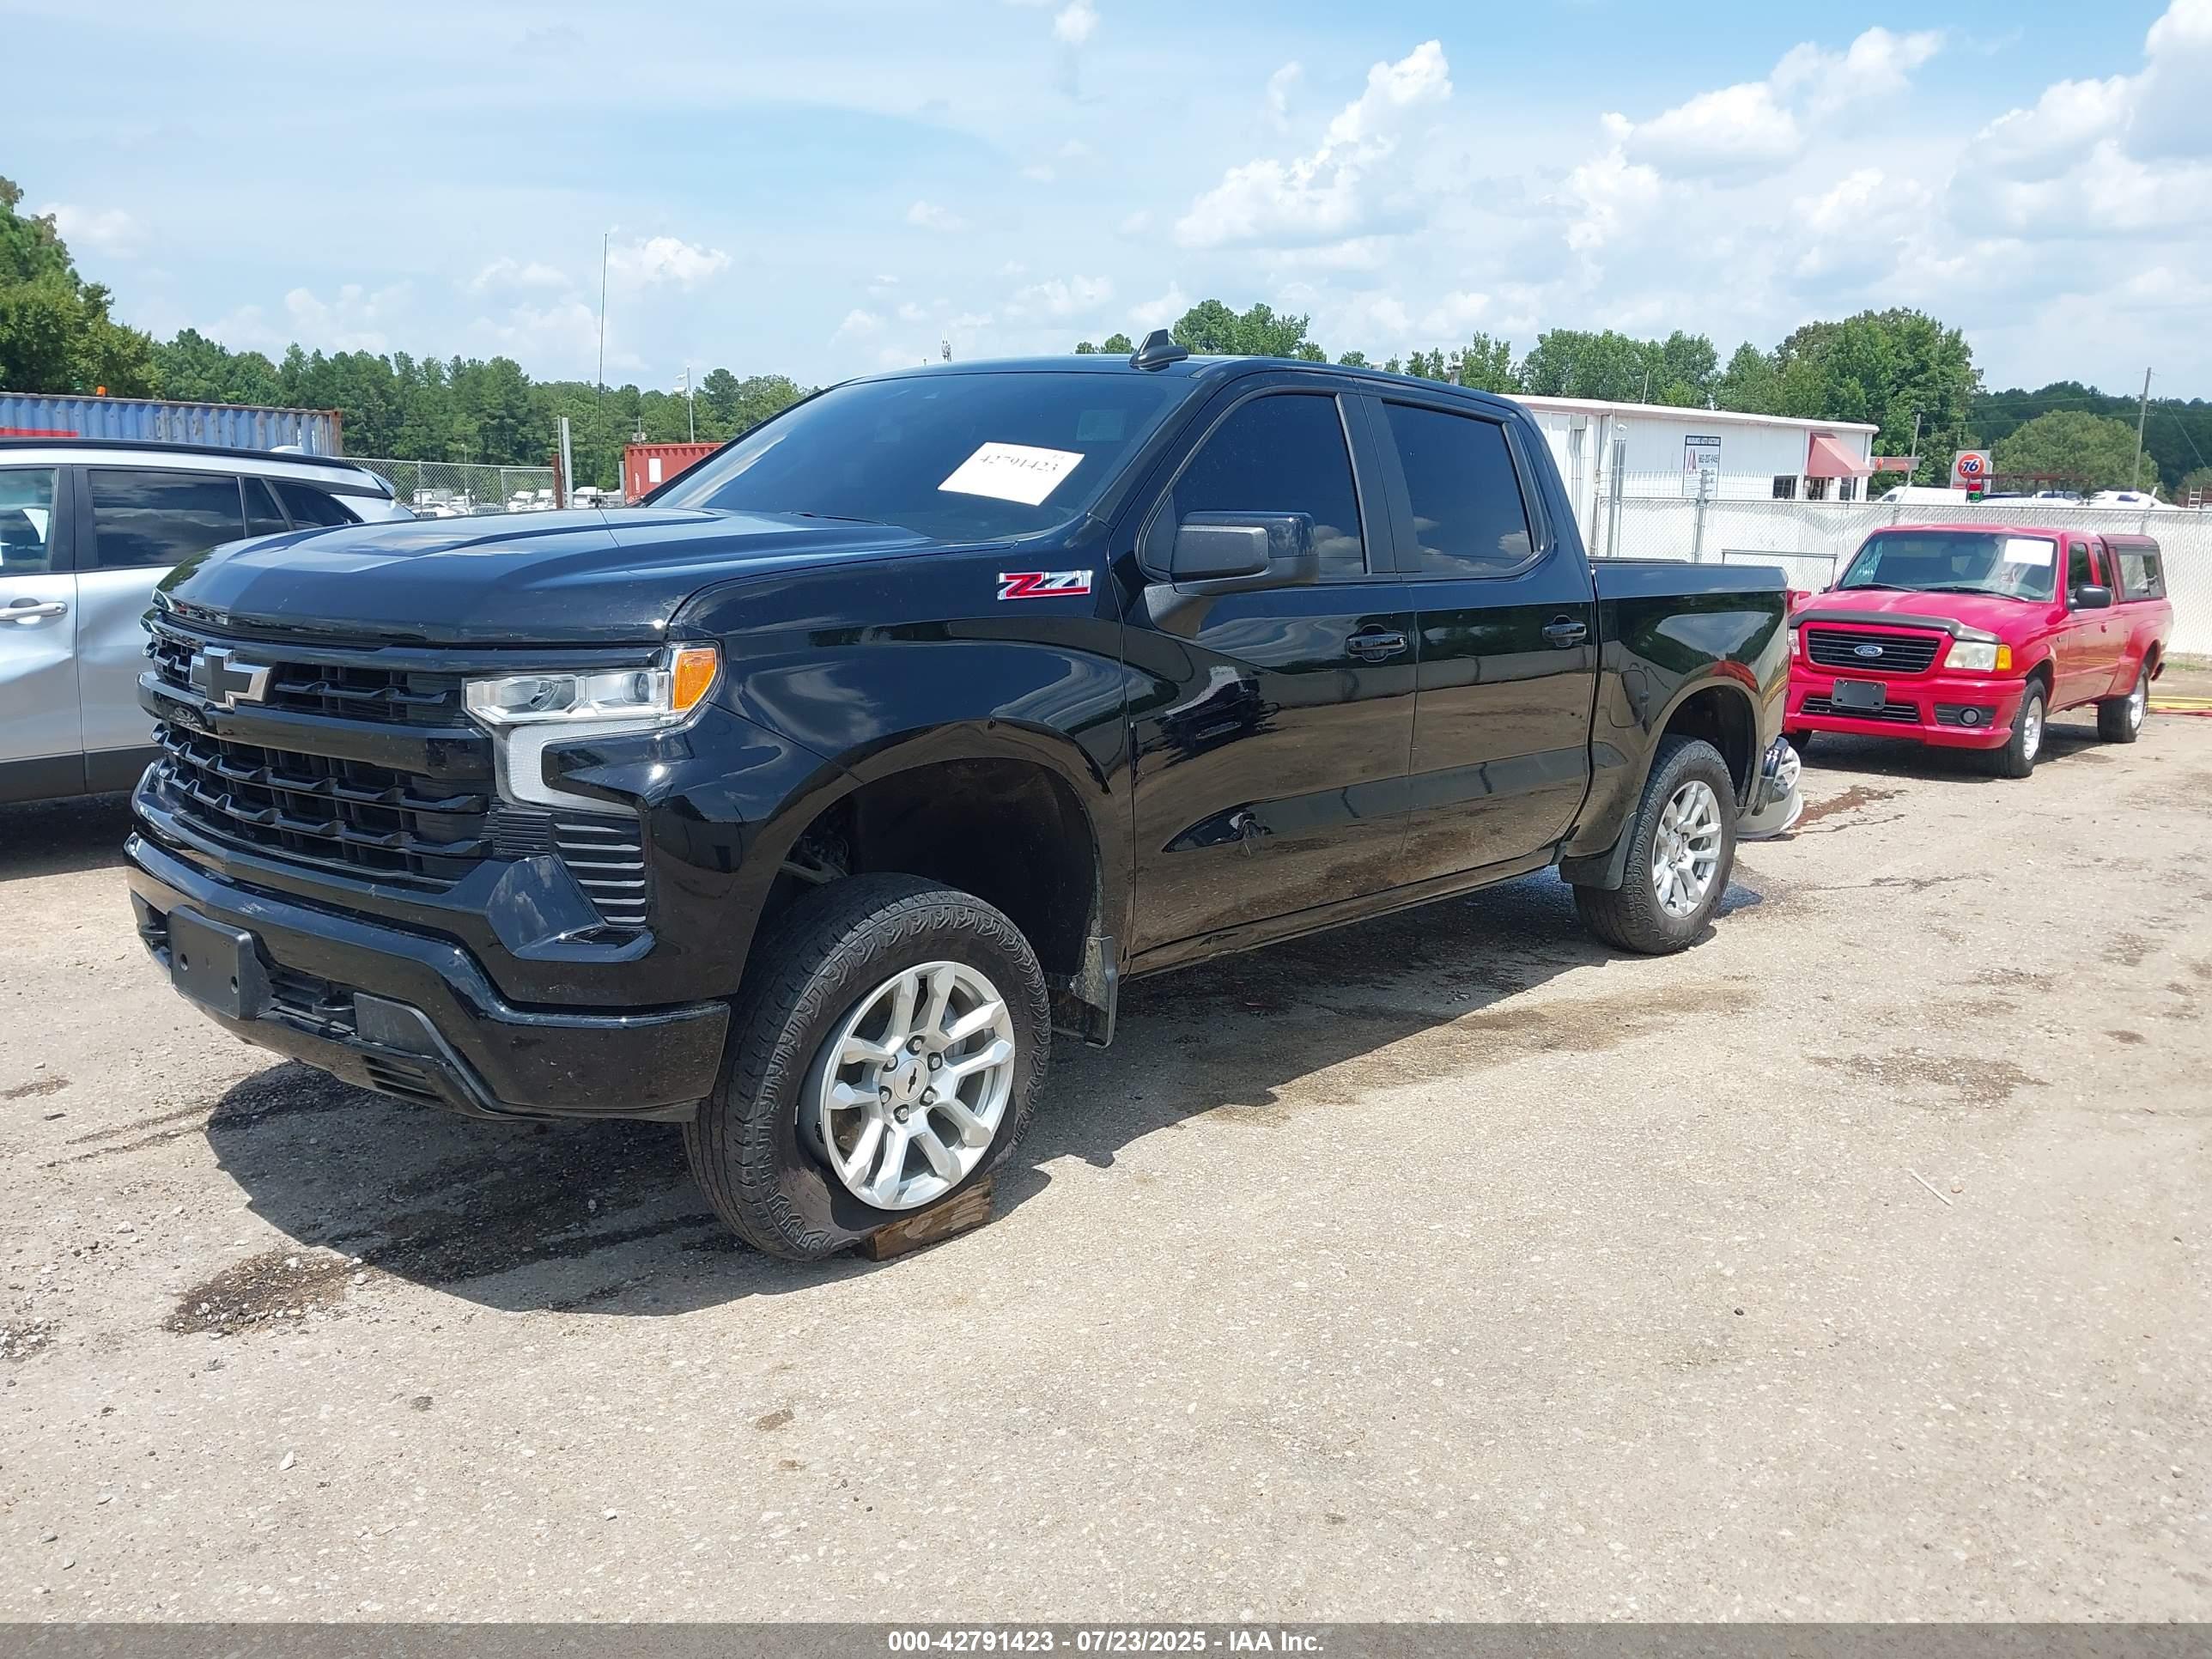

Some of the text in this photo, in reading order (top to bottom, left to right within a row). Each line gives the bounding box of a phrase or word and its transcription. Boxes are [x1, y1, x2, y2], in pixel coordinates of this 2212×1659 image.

[979, 453, 1060, 472] 42791423
[1961, 459, 1980, 473] 76
[997, 569, 1093, 600] Z71
